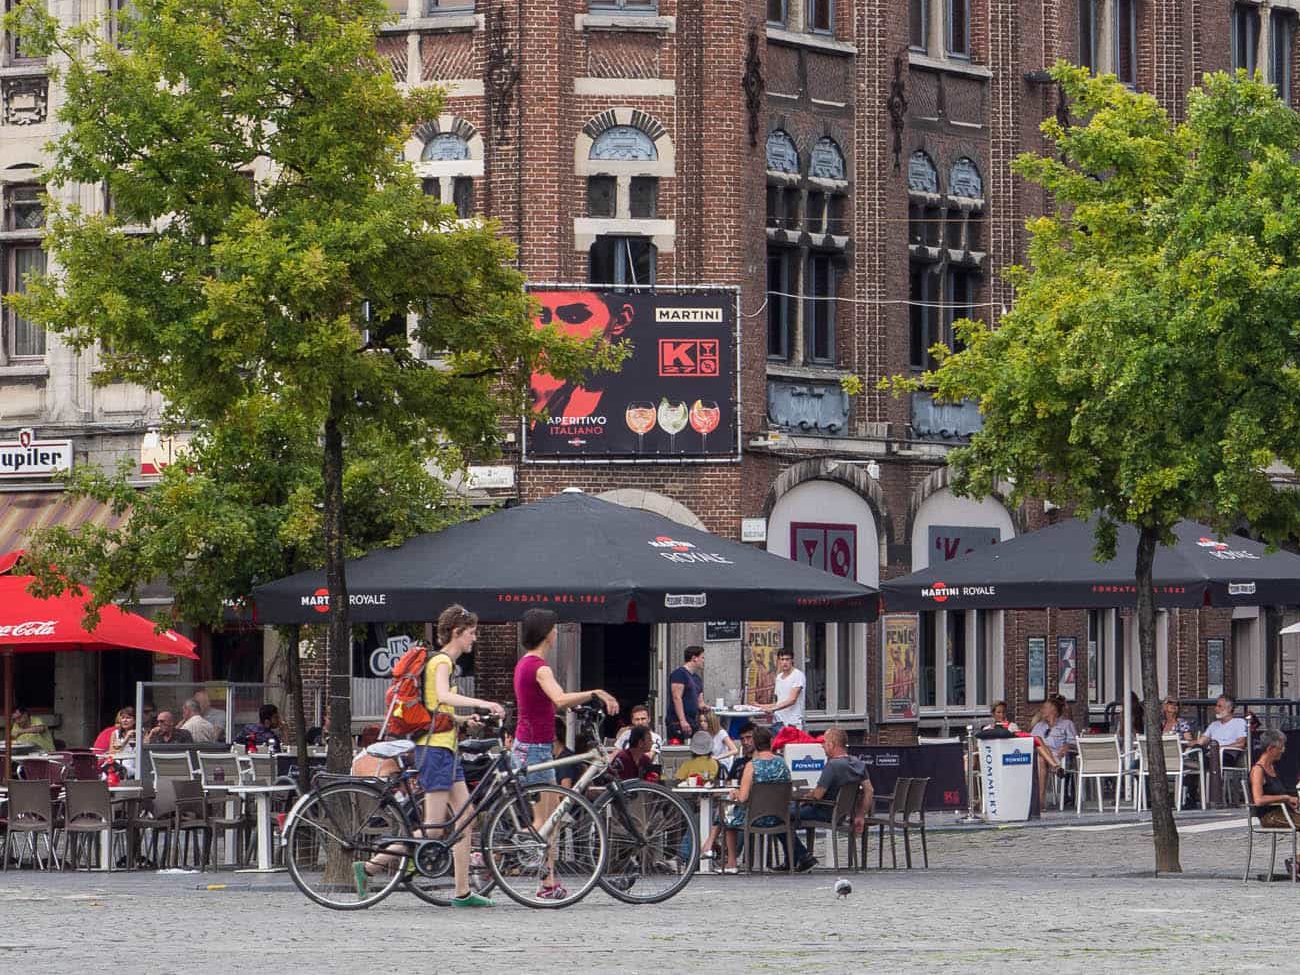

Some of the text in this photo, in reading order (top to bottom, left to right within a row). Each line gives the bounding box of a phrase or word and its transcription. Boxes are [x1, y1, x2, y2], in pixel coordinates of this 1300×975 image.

[659, 310, 719, 320] MARTINI
[546, 416, 607, 425] APERITIVO
[550, 426, 604, 435] ITALIANO
[921, 586, 996, 597] MARTINI ROYALE
[301, 594, 386, 606] MART ROYALE
[985, 745, 998, 816] POMMERY
